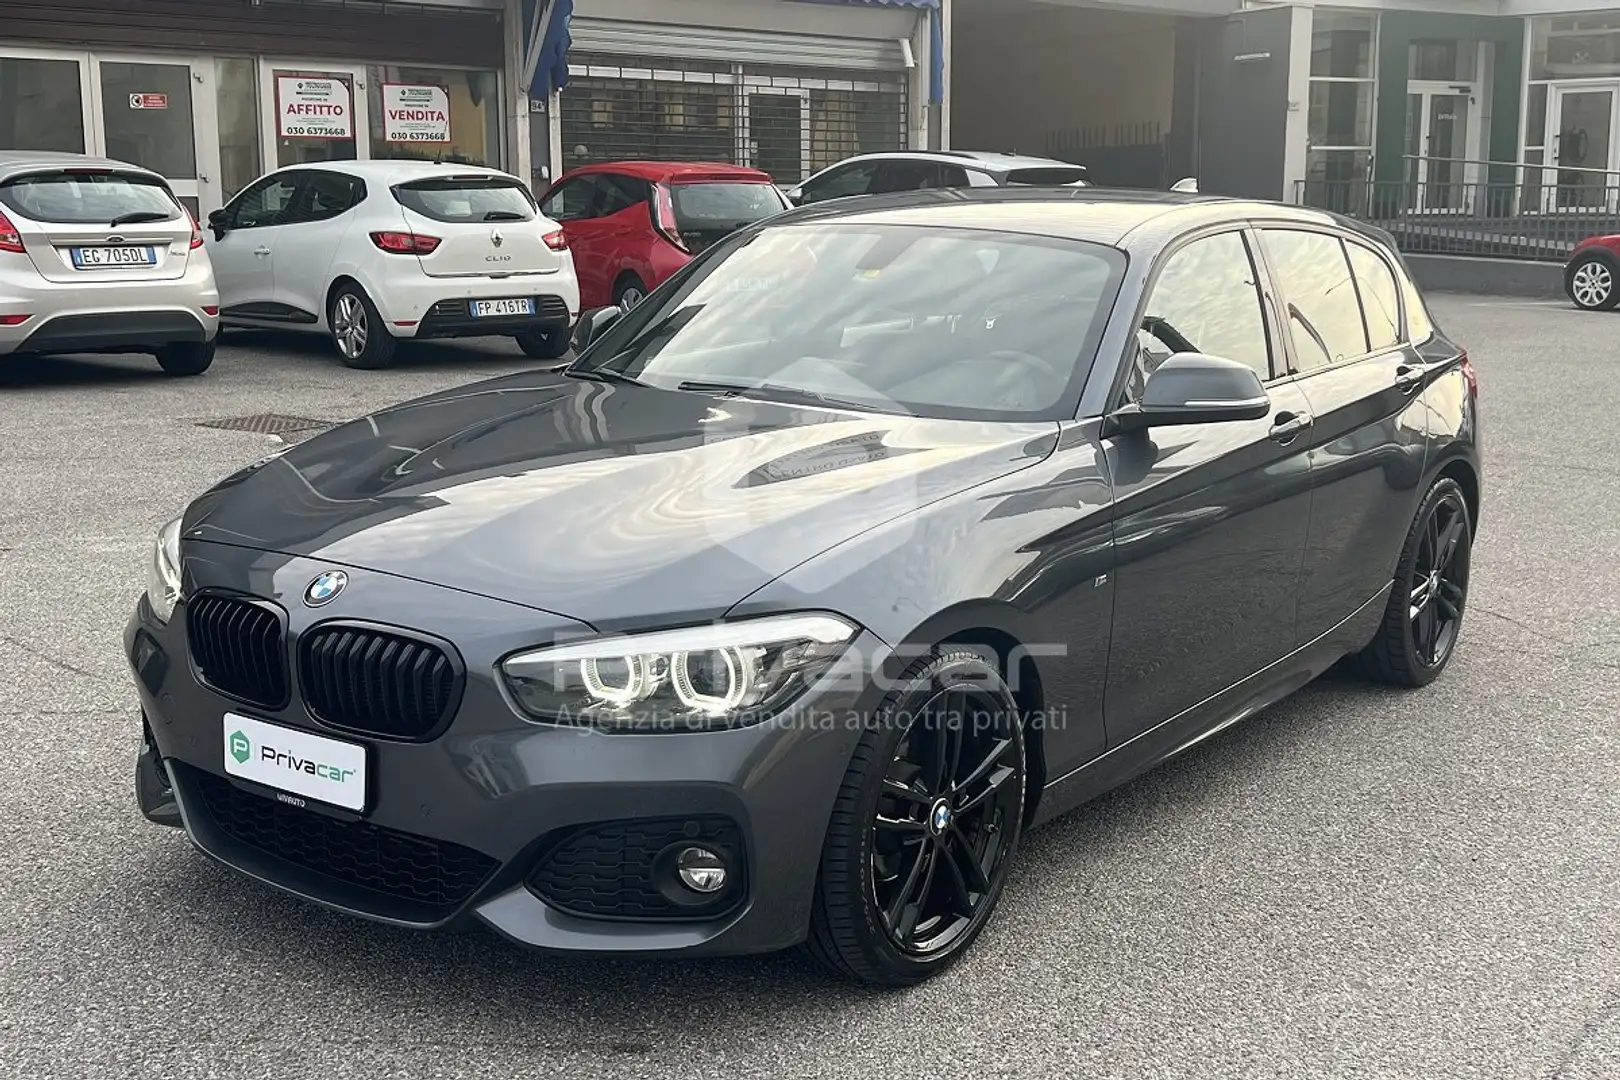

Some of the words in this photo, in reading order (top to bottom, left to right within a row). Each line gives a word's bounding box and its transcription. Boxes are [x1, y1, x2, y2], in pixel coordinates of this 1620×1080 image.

[286, 103, 344, 116] AFFITTO
[388, 109, 446, 121] VENDITA
[286, 126, 305, 135] 030
[306, 127, 346, 136] 6373668
[391, 132, 408, 140] 030
[409, 132, 446, 140] 6373668
[104, 248, 148, 262] 705DL
[478, 301, 492, 314] FP
[261, 745, 354, 783] Privacar
